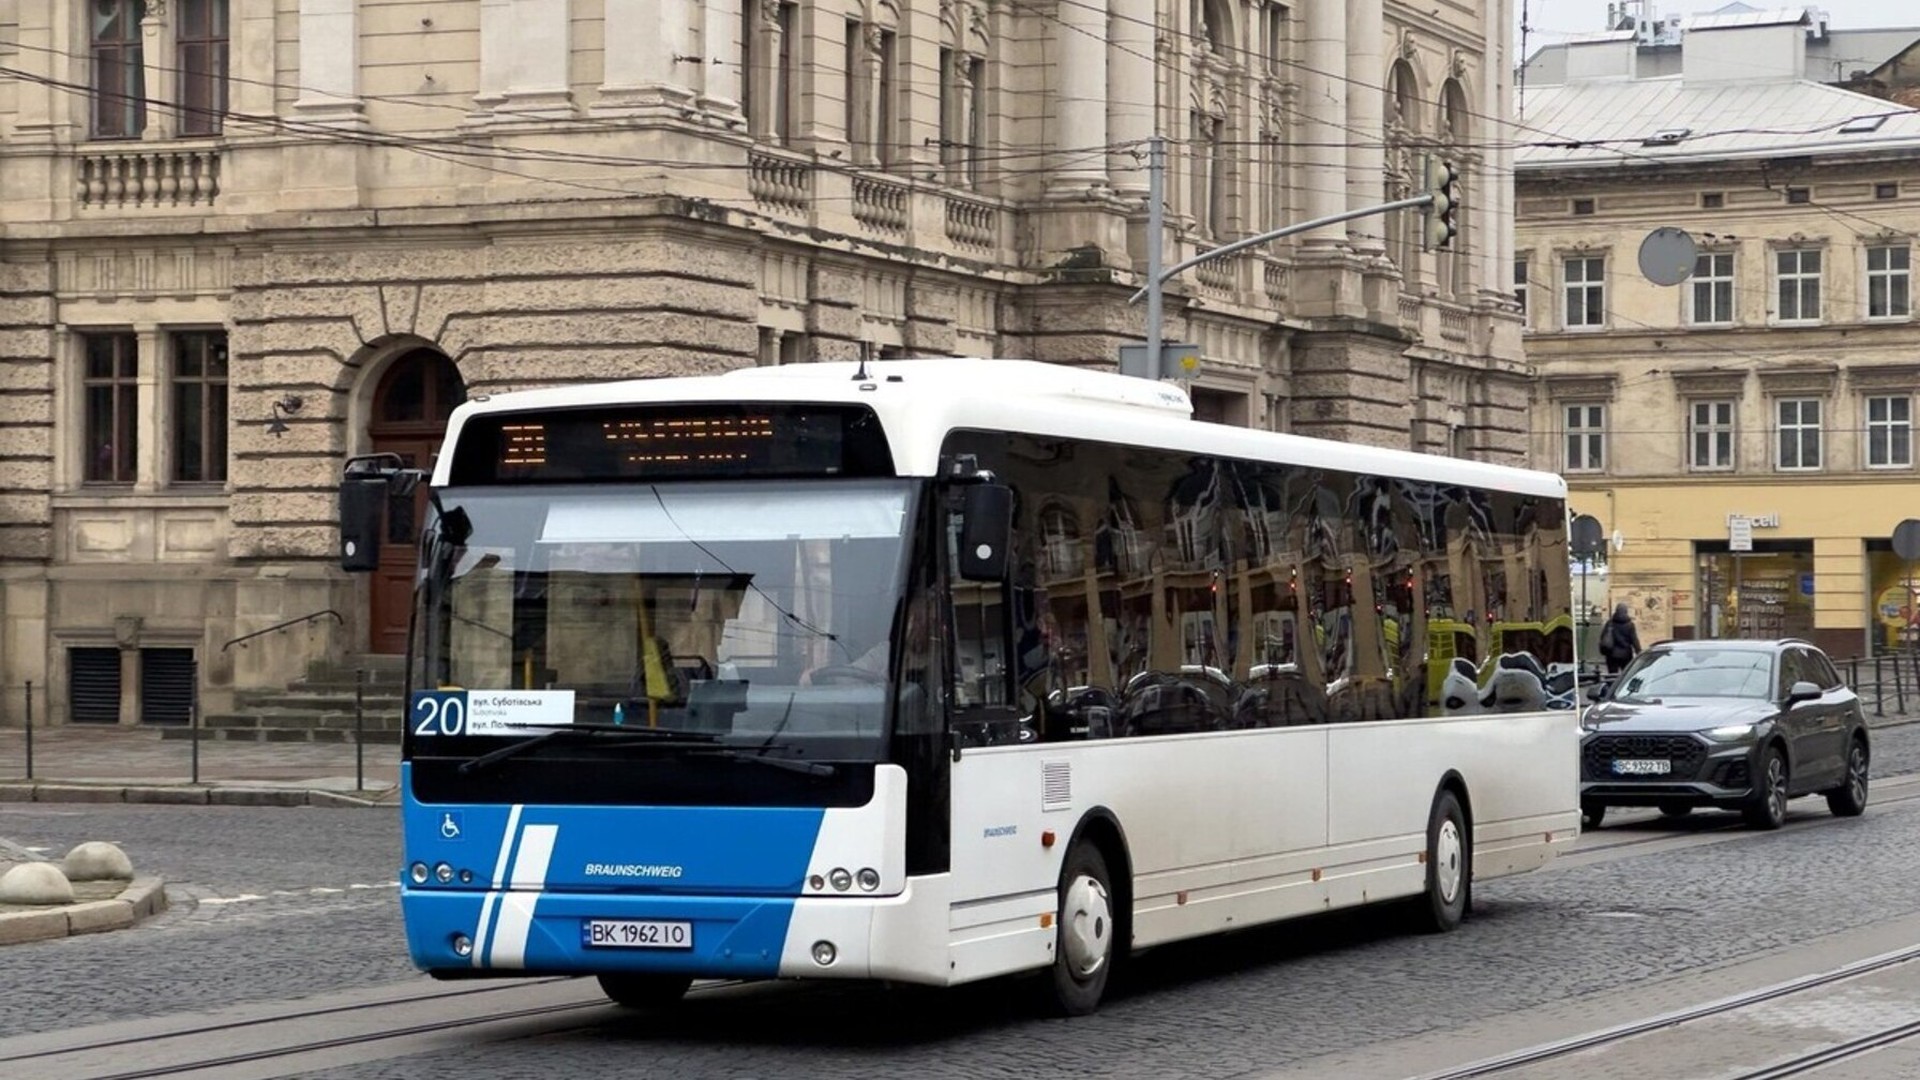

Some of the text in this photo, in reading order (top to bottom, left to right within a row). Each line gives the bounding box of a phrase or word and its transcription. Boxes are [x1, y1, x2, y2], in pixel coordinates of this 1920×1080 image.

[492, 698, 542, 707] Суботівська
[415, 697, 464, 736] 20
[585, 863, 682, 877] BRAUNSCHWEIG
[592, 924, 617, 942] BK
[620, 924, 658, 943] 1962
[664, 925, 684, 943] IO
